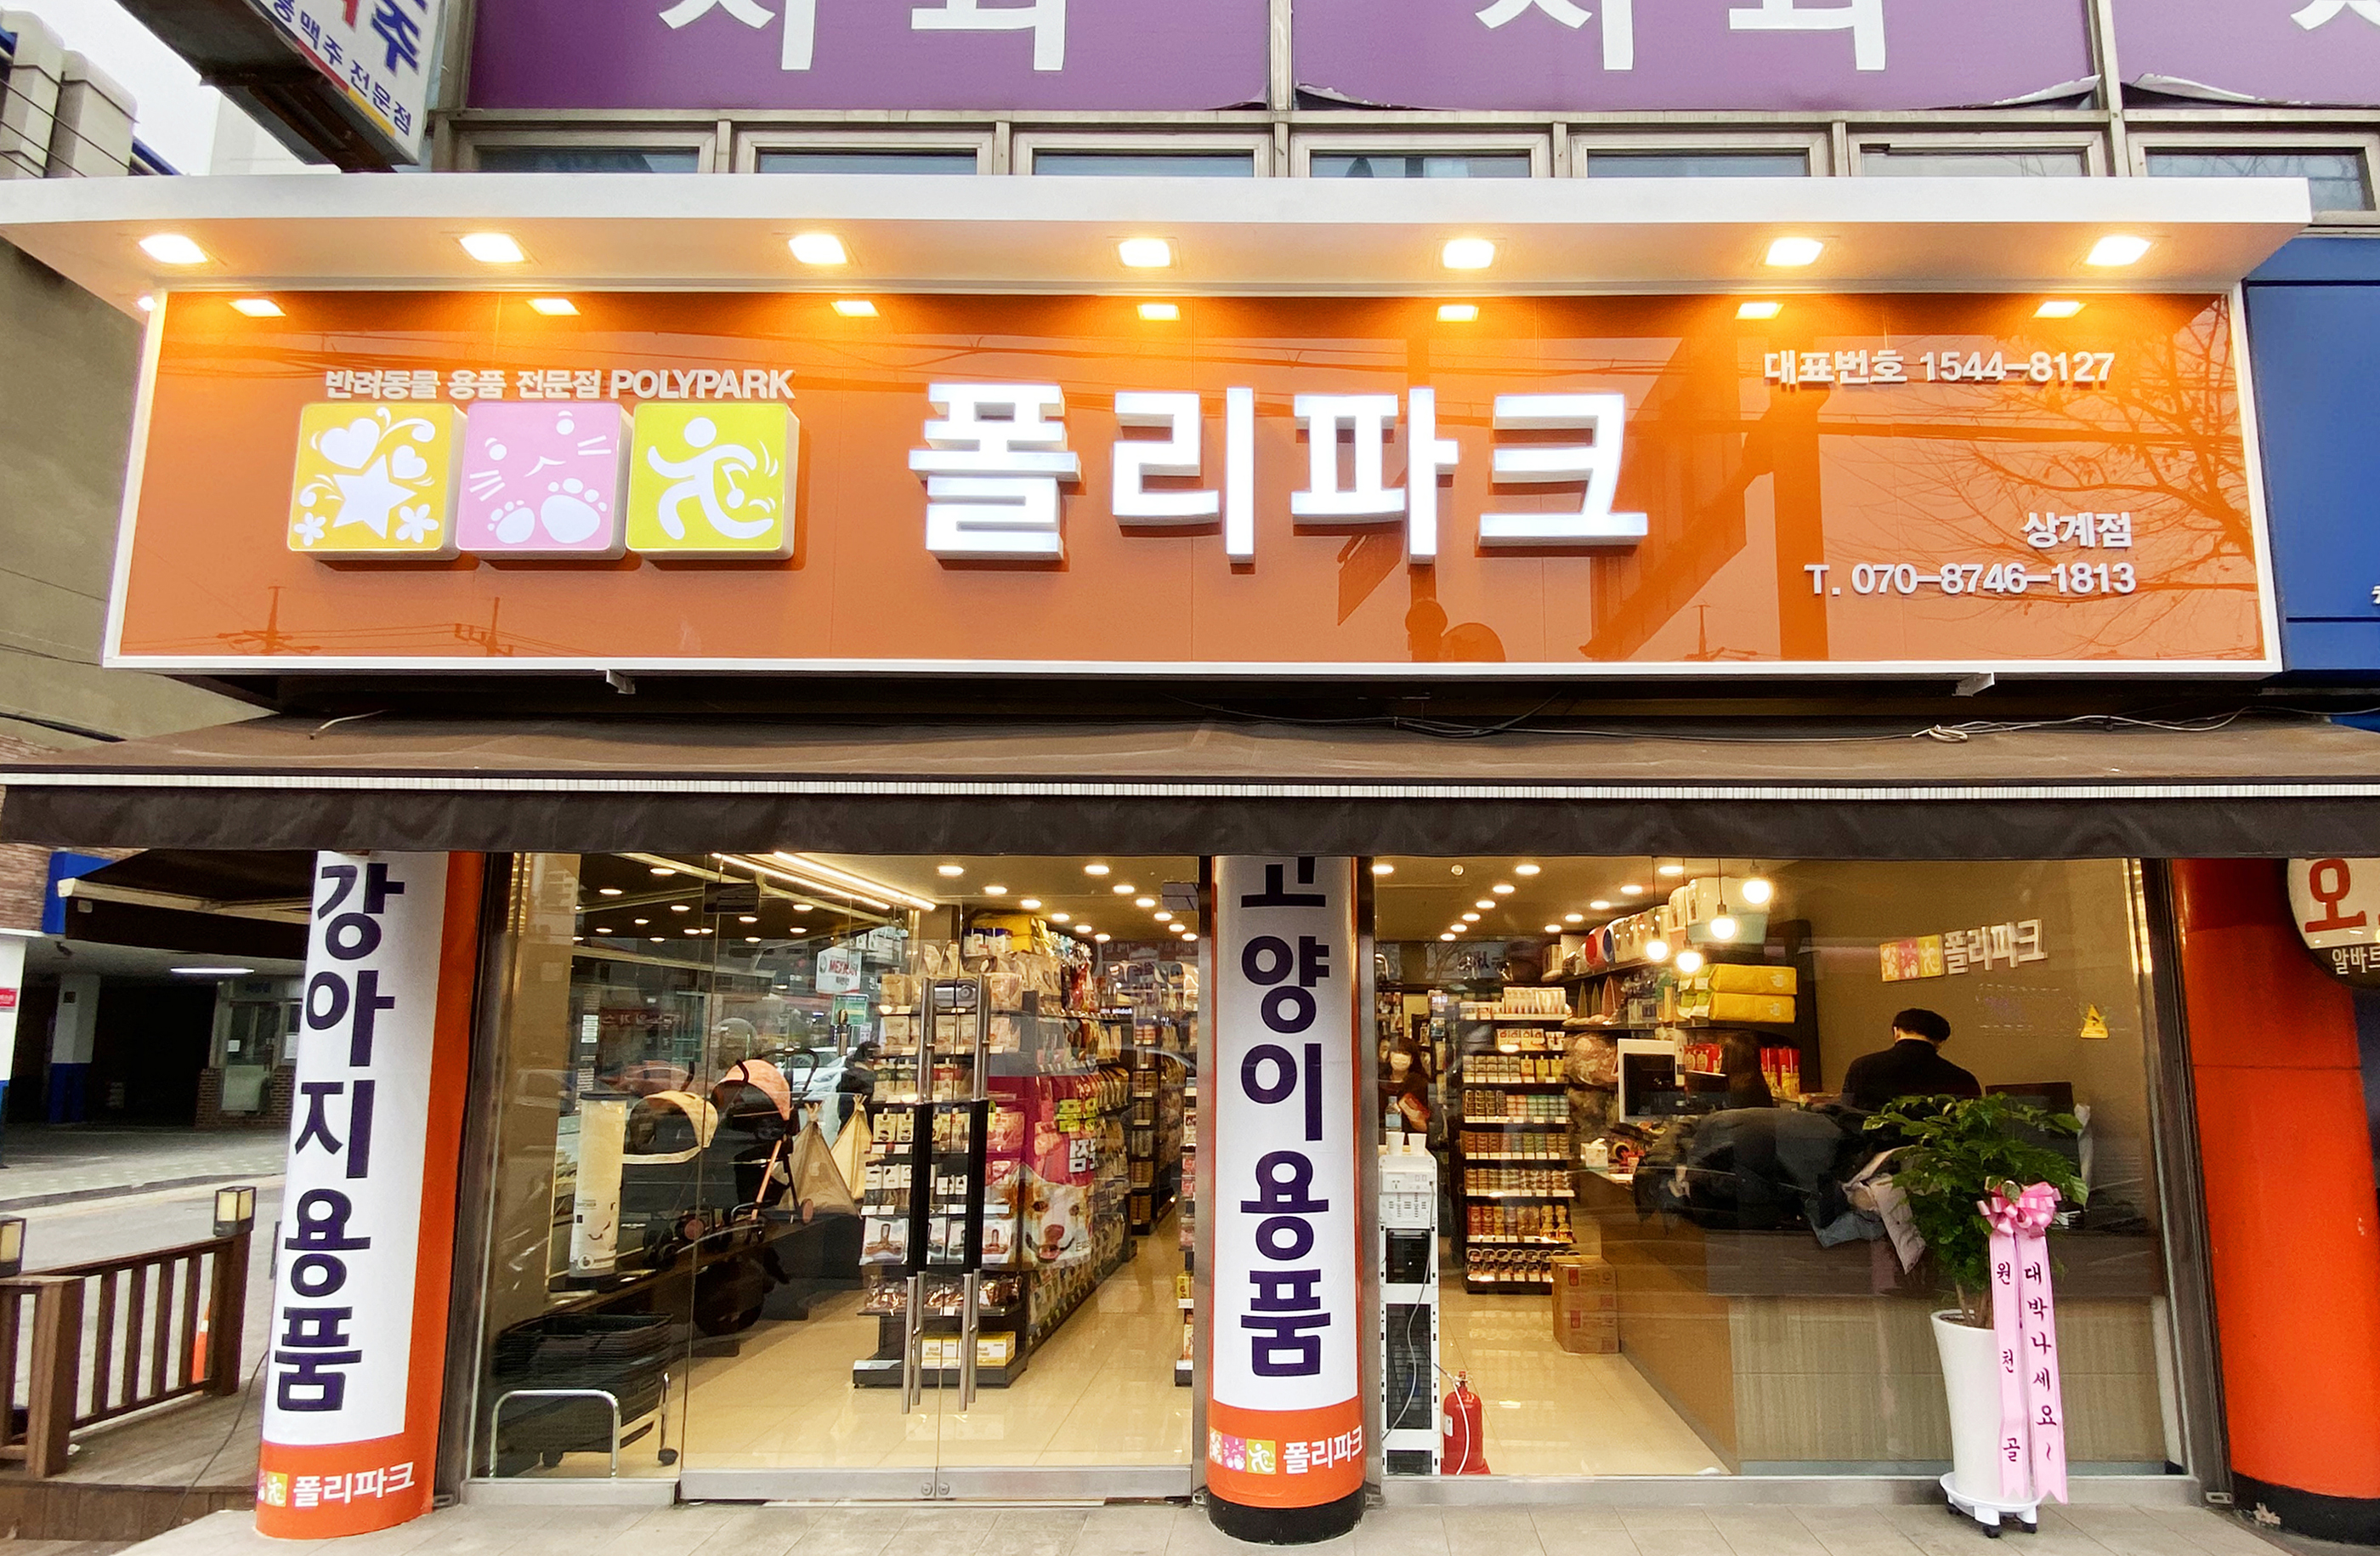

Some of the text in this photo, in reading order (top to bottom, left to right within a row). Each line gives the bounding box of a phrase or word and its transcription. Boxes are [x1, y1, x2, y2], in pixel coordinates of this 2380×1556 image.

[350, 60, 411, 136] 전문점
[326, 369, 796, 400] 반려동물 용품 전문점 POLYPARK
[1764, 349, 2116, 384] 대표번호 1544-8127
[908, 383, 1649, 565] 폴리파크
[2021, 512, 2133, 548] 상계점
[1804, 563, 2137, 595] T. 070-8746-1813
[1944, 919, 2048, 975] 폴리파크
[275, 862, 405, 1412] 강아지용품
[1282, 1425, 1363, 1474] 폴리파크
[292, 1461, 416, 1508] 폴리파크
